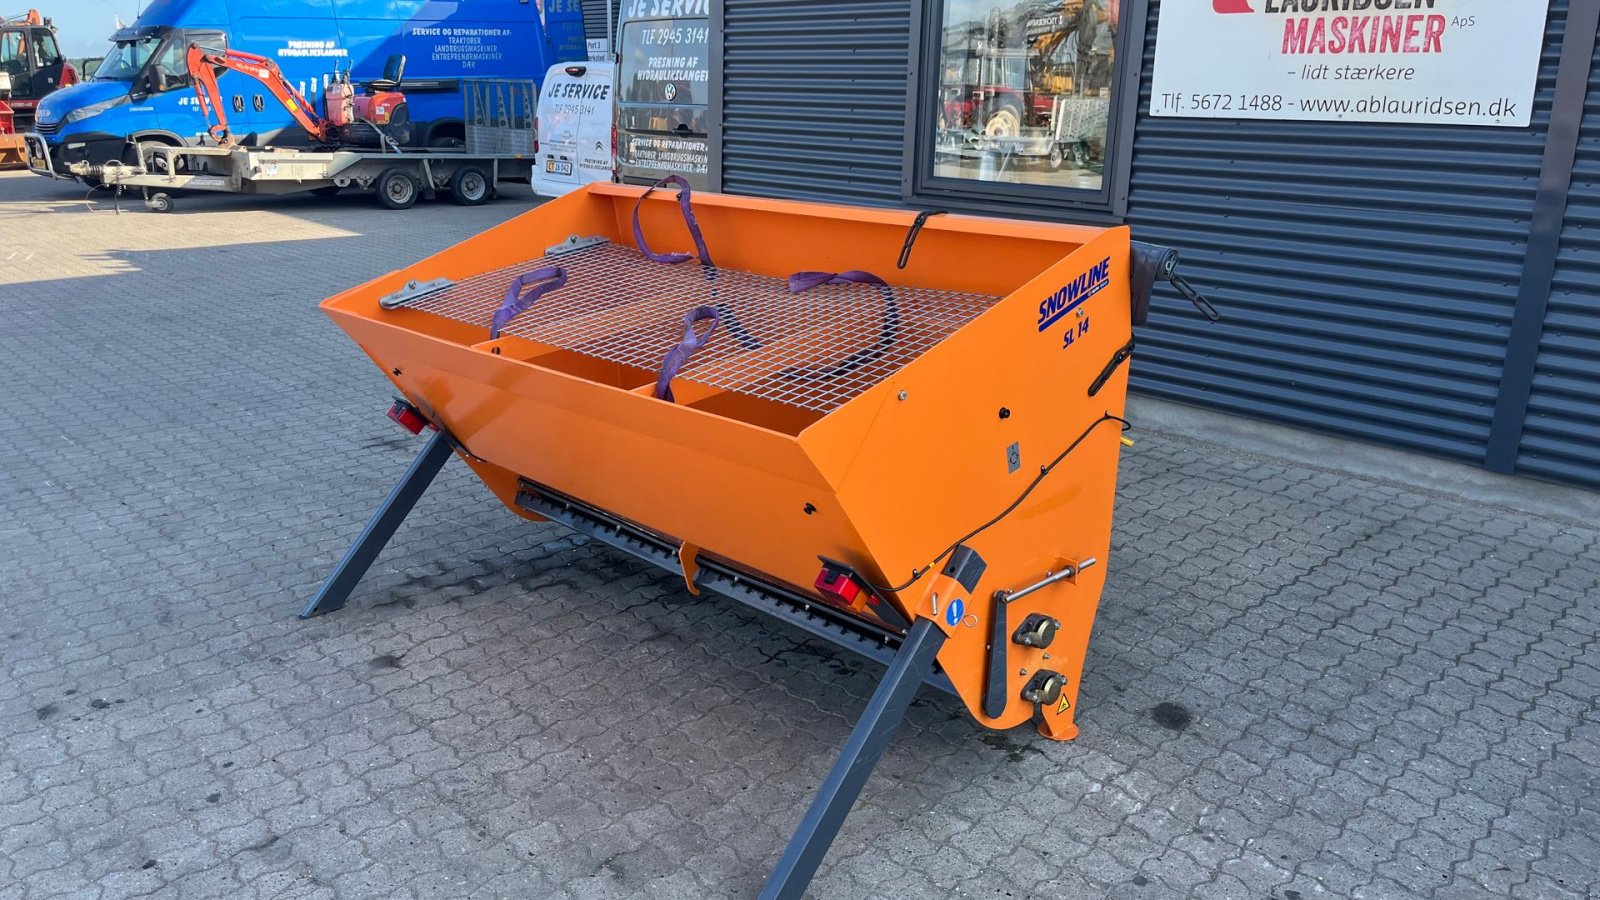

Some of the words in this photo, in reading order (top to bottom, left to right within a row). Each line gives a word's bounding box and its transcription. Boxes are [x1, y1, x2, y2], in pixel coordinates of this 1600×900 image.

[628, 0, 647, 18] JE
[412, 28, 440, 36] SERVICE
[442, 28, 452, 36] OG
[453, 28, 502, 37] REPARATIONER
[449, 37, 481, 45] TRAKTORER
[641, 29, 655, 45] TLF
[657, 28, 682, 46] 2945
[685, 27, 709, 44] 3141
[1281, 15, 1446, 54] MASKINER
[1451, 15, 1475, 29] ApS
[434, 45, 498, 53] LANDBRUGSMASKINER
[648, 57, 686, 68] PRESNING
[687, 57, 699, 68] AF
[1301, 64, 1329, 80] lidt
[1334, 64, 1415, 81] stærkere
[548, 83, 561, 98] JE
[562, 83, 610, 100] SERVICE
[178, 97, 189, 105] JE
[1162, 92, 1185, 113] Tlf.
[1191, 94, 1232, 110] 5672
[1238, 94, 1283, 112] 1488
[1300, 95, 1516, 118] www.ablauridsen.dk
[632, 138, 652, 148] SERVICE
[661, 140, 705, 152] REPARATIONER
[1038, 256, 1111, 324] SNOWLINE
[1063, 328, 1074, 350] SL
[1078, 316, 1090, 338] 14
